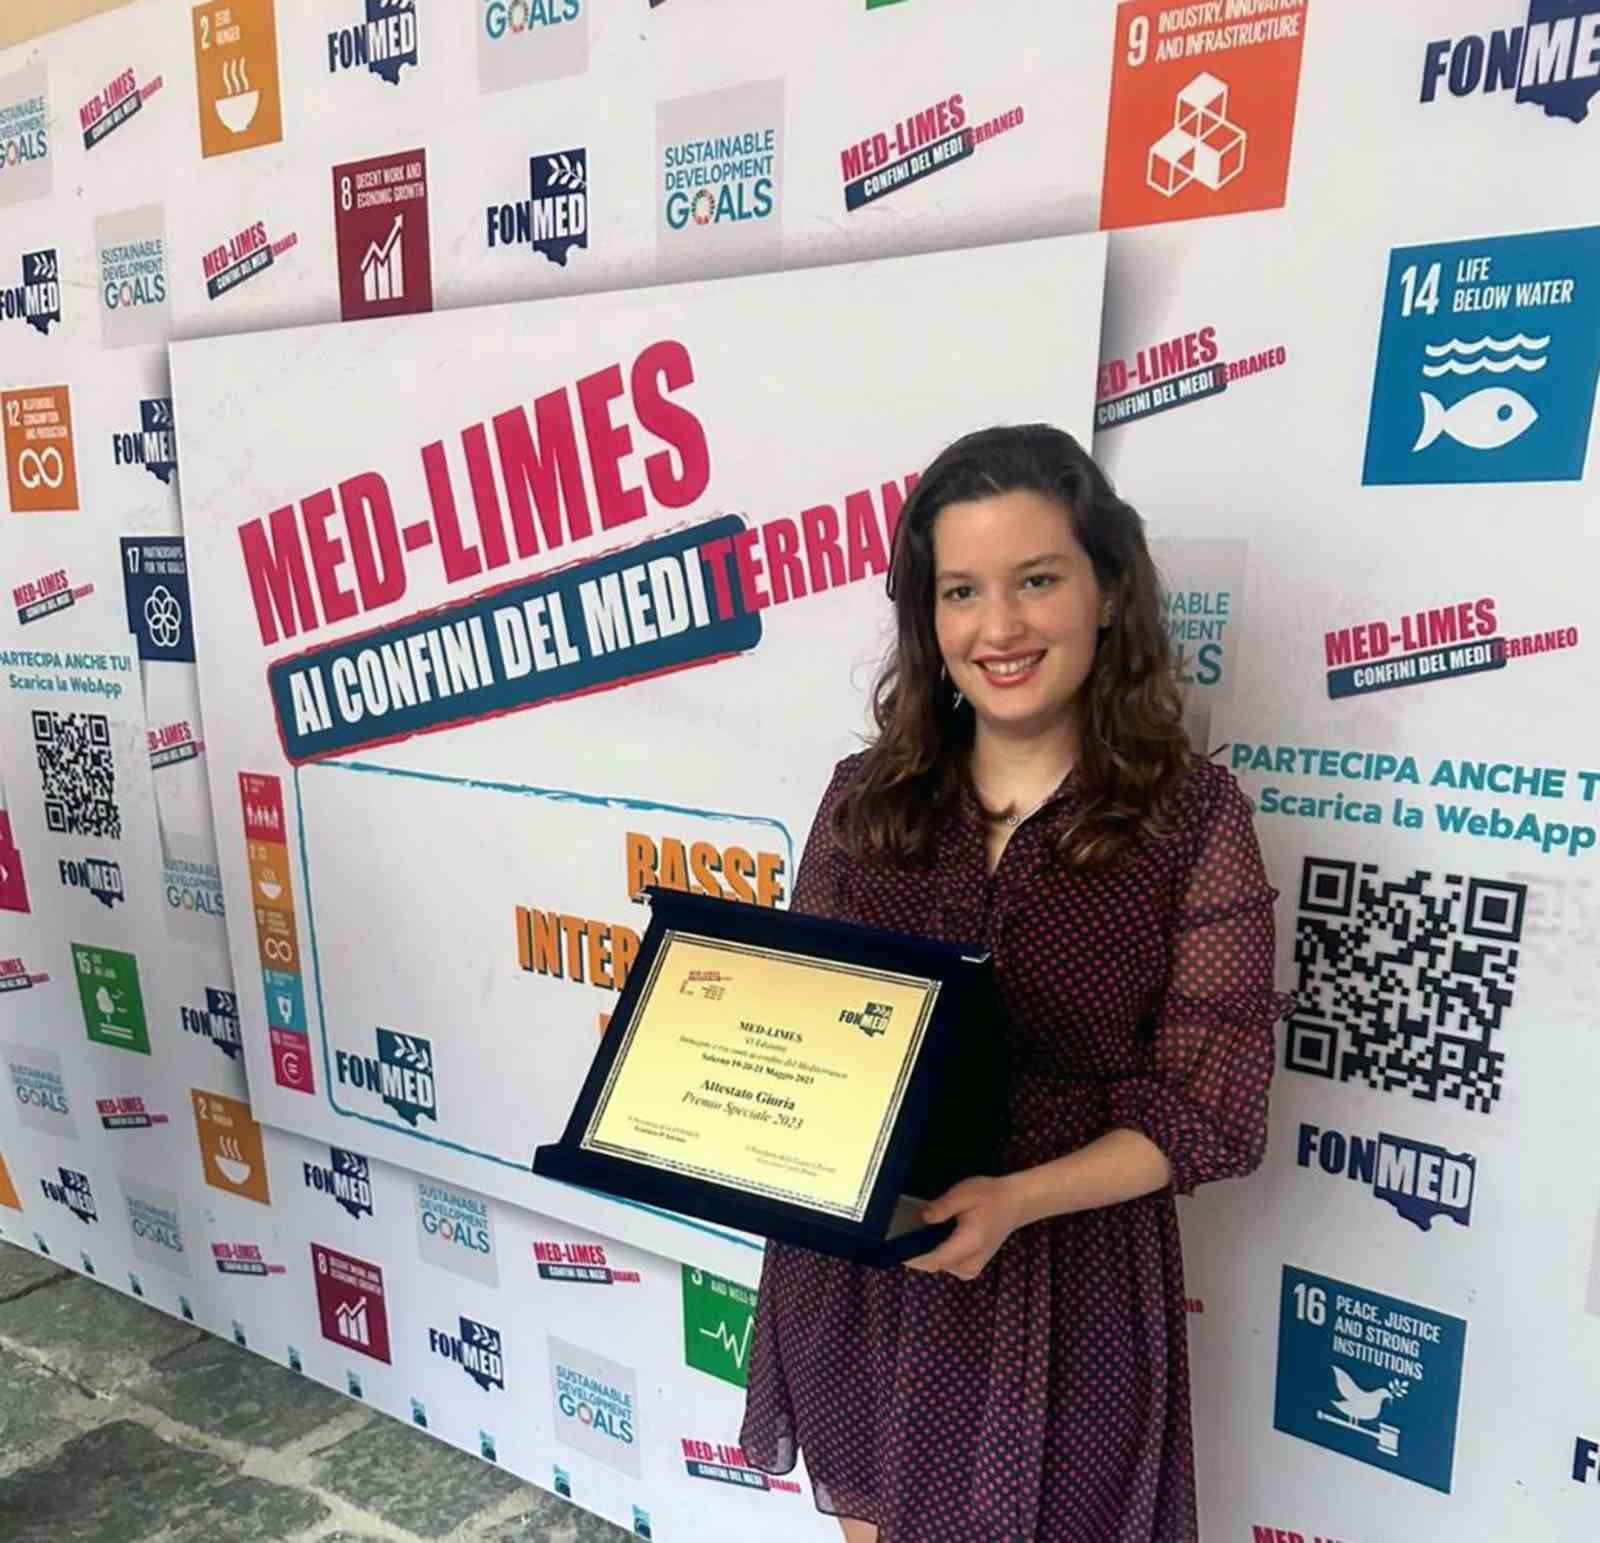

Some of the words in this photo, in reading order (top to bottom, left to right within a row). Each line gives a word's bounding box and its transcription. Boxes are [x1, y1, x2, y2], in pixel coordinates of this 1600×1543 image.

[200, 16, 210, 49] 2
[327, 12, 414, 73] FONMED
[1128, 15, 1150, 67] 9
[1155, 36, 1184, 62] AND
[1186, 14, 1300, 56] INFRASTRUCTURE
[1420, 13, 1600, 103] FONME
[665, 130, 775, 167] SUSTAINABLE
[840, 94, 967, 182] MED-LIMES
[341, 176, 352, 210] 8
[665, 155, 774, 191] DEVELOPMENT
[863, 164, 910, 196] CONFINI
[911, 157, 932, 176] DEL
[487, 192, 586, 247] FONMED
[666, 178, 773, 230] GOALS
[102, 239, 163, 265] SUSTAINABLE
[103, 260, 163, 281] DEVELOPMENT
[202, 220, 268, 278] MED-LIMES
[1456, 256, 1491, 283] LIFE
[105, 275, 166, 310] GOALS
[1400, 262, 1442, 317] 14
[1452, 282, 1511, 313] BELOW
[1515, 278, 1574, 306] WATER
[1099, 326, 1218, 400] ED-LIMES
[1098, 391, 1150, 424] CONFINI
[1152, 386, 1177, 407] DEL
[238, 339, 711, 646] MED-LIMES
[127, 547, 140, 573] 17
[288, 670, 331, 735] AI
[331, 621, 494, 725] CONFINI
[493, 591, 580, 682] DEL
[574, 472, 919, 659] MEDITERRAN
[1325, 598, 1498, 666] MED-LIMES
[64, 654, 108, 670] ANCHE
[110, 655, 132, 671] TU!
[1353, 656, 1416, 688] CONFINI
[1418, 655, 1447, 676] DEL
[9, 674, 54, 691] Scarica
[56, 675, 68, 691] la
[69, 677, 122, 699] WebApp
[1231, 742, 1420, 785] PARTECIPA
[1429, 758, 1567, 798] ANCHE
[1260, 786, 1382, 825] Scarica
[1393, 798, 1423, 829] la
[1436, 804, 1596, 856] WebApp
[58, 859, 123, 896] FONMED
[515, 905, 641, 993] INTER
[739, 1020, 804, 1043] MED-LIMES
[336, 1050, 435, 1109] FONMED
[700, 1079, 753, 1101] Attestato
[723, 1100, 772, 1122] Speciale
[773, 1112, 804, 1131] 2023
[303, 1162, 371, 1207] FONMED
[1298, 1122, 1472, 1209] FONMED
[422, 1211, 490, 1254] GOALS
[534, 1242, 606, 1265] MED-LIMES
[1293, 1282, 1326, 1326] 16
[1334, 1315, 1363, 1340] AND
[1365, 1324, 1419, 1358] STRONG
[1384, 1311, 1441, 1343] JUSTICE
[429, 1328, 502, 1381] FONMED
[1332, 1335, 1423, 1381] INSTITUTIONS
[559, 1393, 633, 1444] GOALS
[682, 1438, 750, 1468] MED-LIM
